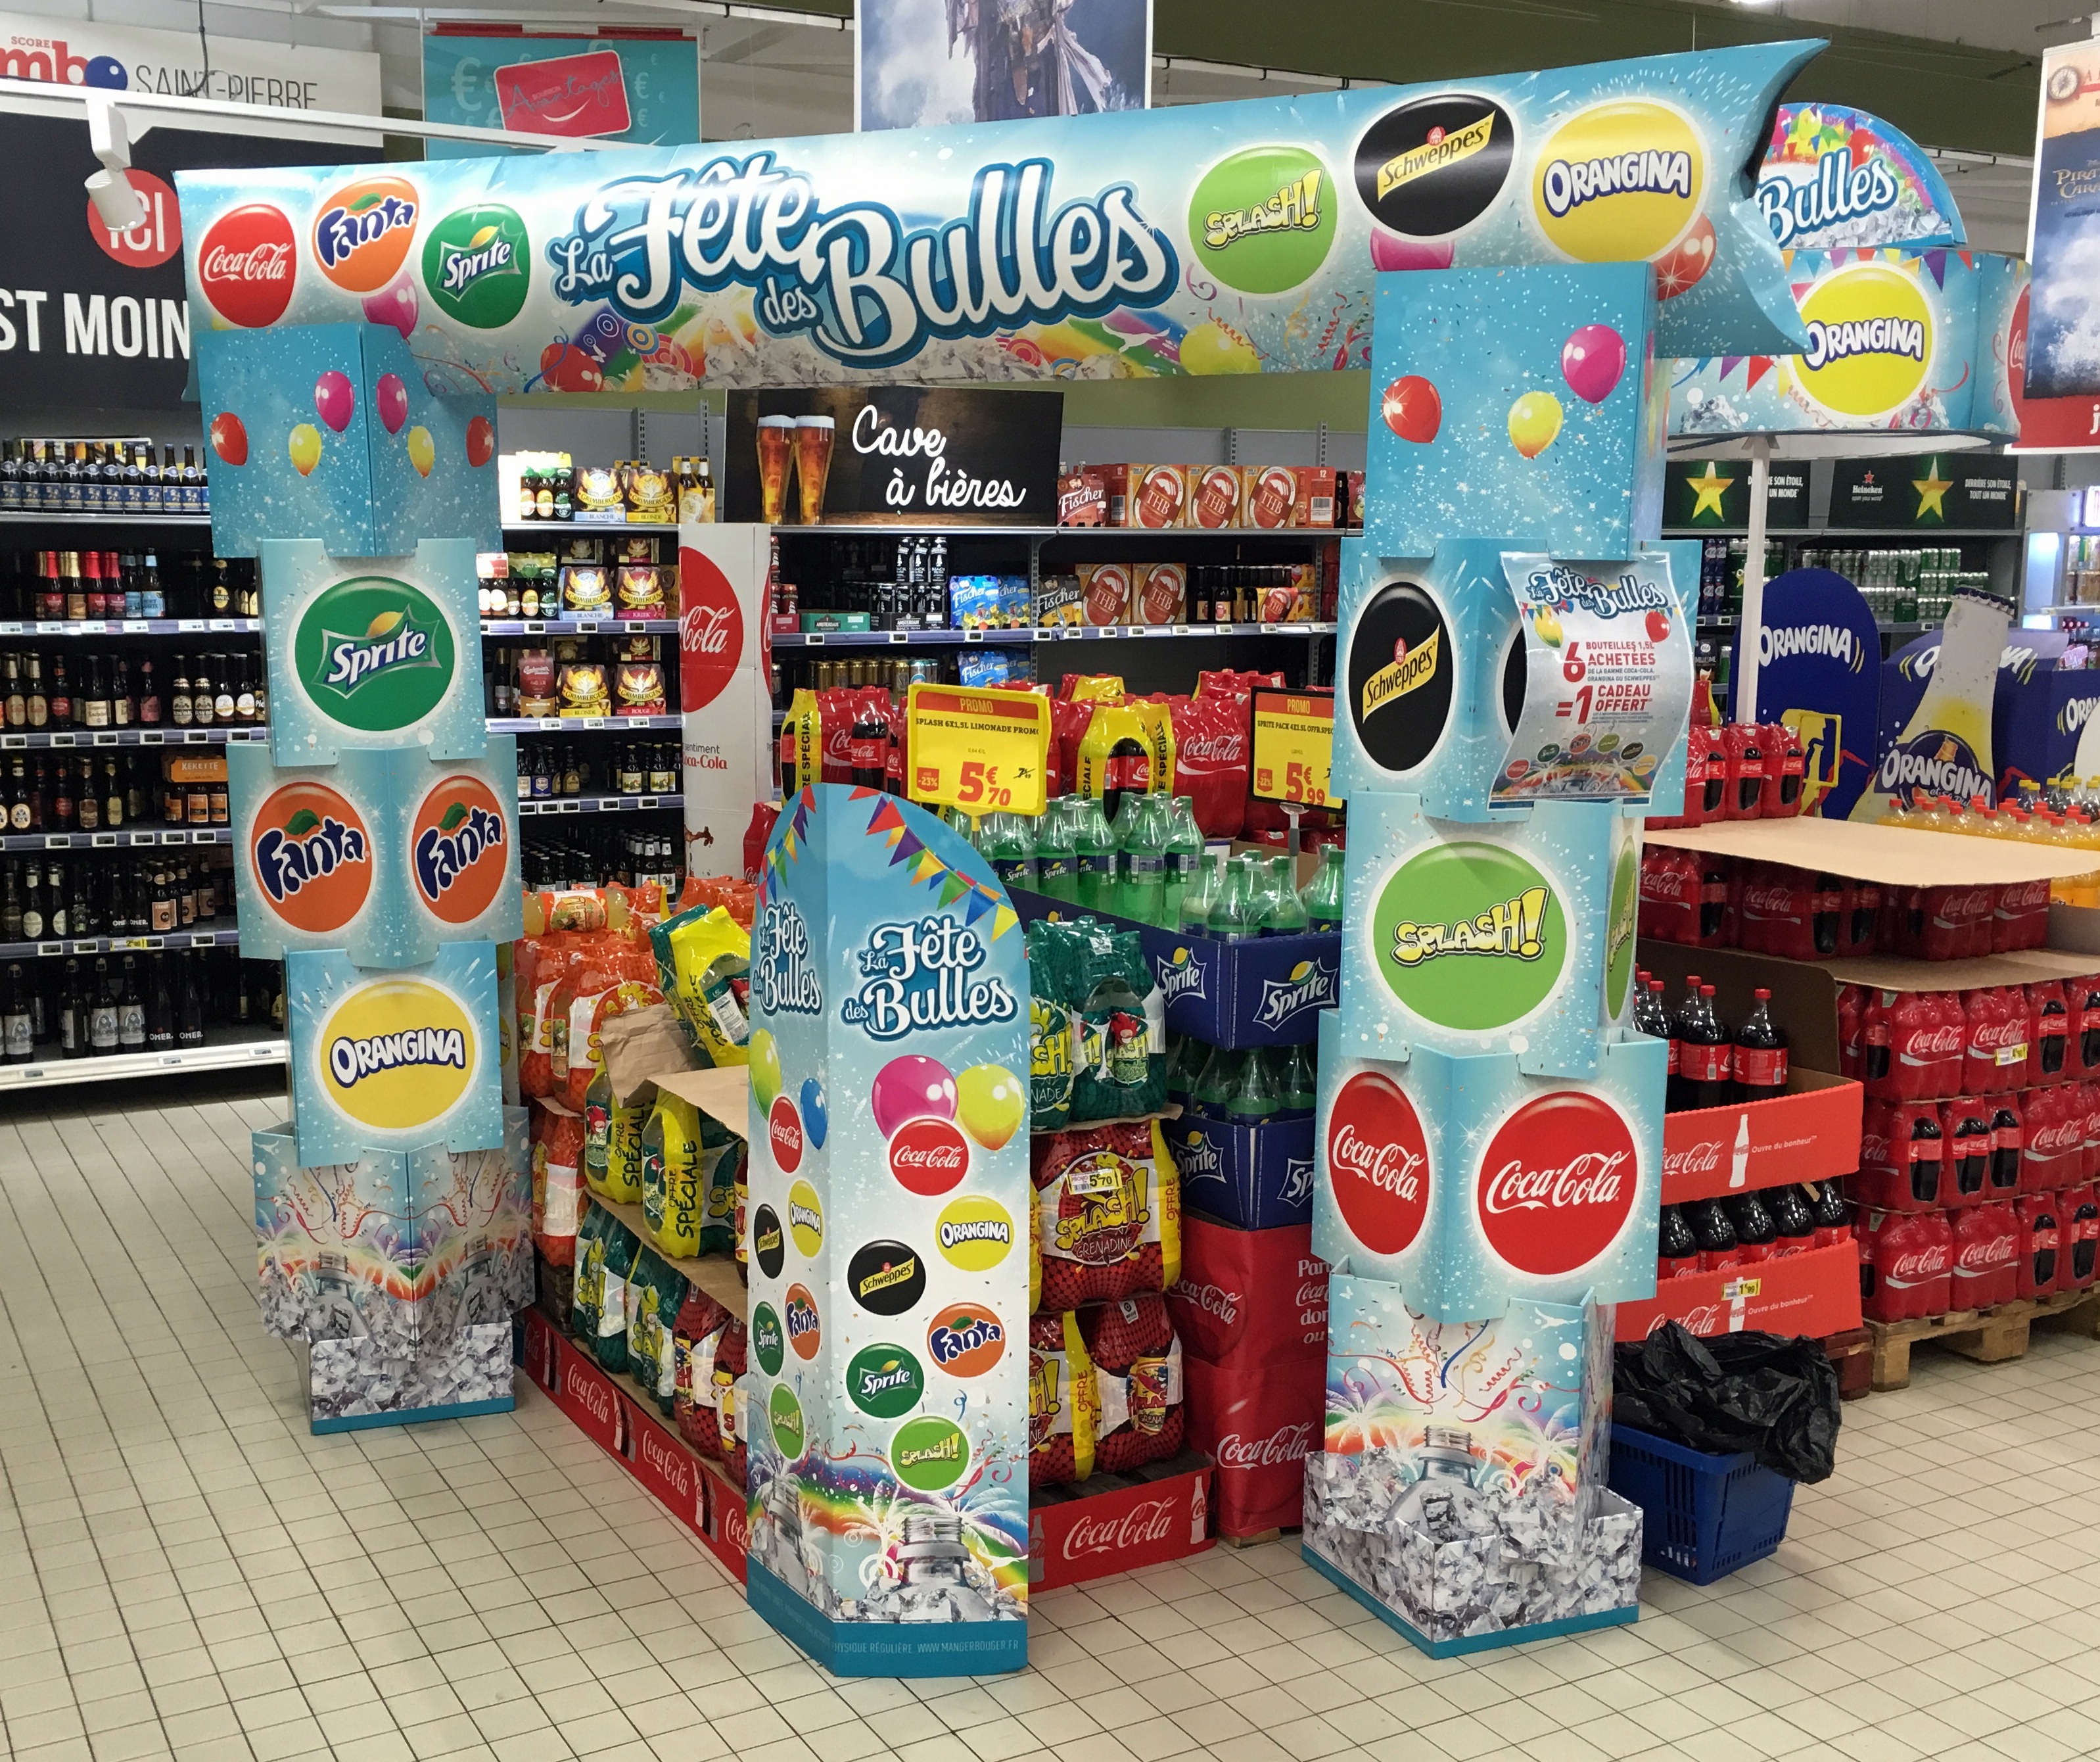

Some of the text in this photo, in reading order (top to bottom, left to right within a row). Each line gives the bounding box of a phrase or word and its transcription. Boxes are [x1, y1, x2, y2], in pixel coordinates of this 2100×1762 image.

[11, 36, 51, 48] SCORE
[1383, 125, 1485, 188] Schweppes
[1543, 150, 1692, 218] ORANGINA
[1760, 149, 1896, 243] Bulles
[1203, 168, 1322, 249] SPLASH!
[317, 196, 415, 267] Fanta
[553, 154, 815, 309] La Fête
[204, 242, 293, 283] Coca-Cola
[443, 238, 511, 291] Sprite
[762, 164, 1167, 356] des Bulles
[1805, 317, 1925, 370] ORANGINA
[852, 405, 946, 458] Cave
[885, 456, 1027, 507] à bières
[1769, 488, 1798, 498] UN MONDE
[1774, 476, 1785, 486] SON
[1852, 485, 1883, 494] Heineken
[581, 493, 623, 505] GRIMBERGEN
[632, 494, 673, 506] GRIMBERGEN
[1058, 486, 1104, 516] Fischer
[1148, 489, 1170, 515] THB
[1205, 489, 1226, 514] THB
[1261, 489, 1284, 514] THB
[568, 591, 609, 604] GRIMBERGEN
[621, 592, 662, 604] GRIMBERGEN
[952, 584, 986, 605] Fischer
[1038, 587, 1080, 616] Fischer
[1094, 588, 1117, 612] THB
[1149, 588, 1173, 612] THB
[1531, 568, 1587, 603] Fête
[1588, 576, 1667, 616] Bulles
[327, 621, 427, 687] Sprite
[1563, 642, 1586, 682] 6
[1586, 641, 1655, 650] BOUTEILLES 1,5L
[1758, 624, 1852, 667] ORANGINA
[962, 661, 994, 679] Fischer
[1366, 646, 1433, 709] Schweppes
[565, 688, 607, 701] GRIMBERGEN
[619, 688, 662, 701] GRIMBERGEN
[960, 698, 994, 714] PROMO
[1286, 698, 1311, 714] PROMO
[1595, 698, 1648, 711] OFFERT
[1598, 684, 1651, 697] CADEAU
[916, 717, 944, 727] SPLASH
[970, 723, 1012, 733] LIMONADE
[1257, 720, 1274, 728] SPRITE
[1183, 735, 1242, 763] Coca-Cola
[181, 761, 218, 771] KEKETTE
[918, 776, 938, 787] -23%
[1882, 748, 1994, 809] ORANGINA
[257, 817, 364, 902] Fanta
[415, 807, 502, 901] Fanta
[1006, 866, 1030, 882] Sprite
[1044, 865, 1067, 880] Sprite
[766, 905, 806, 958] Fête
[1391, 886, 1549, 965] SPLASH!
[862, 917, 982, 980] La Fête
[760, 953, 821, 1011] Bulles
[1160, 964, 1200, 998] Sprite
[1267, 972, 1328, 1018] Sprite
[845, 966, 1014, 1036] des Bulles
[1907, 1025, 1963, 1053] Coca-Cola
[1972, 1018, 2028, 1047] Coca-Cola
[331, 1028, 463, 1085] ORANGINA
[615, 1121, 625, 1159] OFFRE
[771, 1118, 800, 1151] Coca-Cola
[1752, 1144, 1771, 1154] Ouvre
[1774, 1141, 1783, 1151] du
[2032, 1120, 2083, 1149] Coca-Cola
[893, 1144, 965, 1169] Coca-Cola
[1177, 1145, 1218, 1178] Sprite
[1333, 1124, 1426, 1201] Coca-Cola
[668, 1167, 678, 1208] OFFRE
[676, 1139, 697, 1239] SPÉCIALE
[1485, 1149, 1633, 1215] Coca-Cola
[1056, 1167, 1151, 1249] SPLASH!
[1166, 1176, 1176, 1222] OFFRE
[790, 1202, 822, 1237] ORANGINA
[941, 1222, 1010, 1249] ORANGINA
[758, 1231, 780, 1249] Schweppes
[1076, 1234, 1134, 1256] GRENADINE
[1959, 1234, 2015, 1264] Coca-Cola
[862, 1262, 912, 1292] Schweppes
[1893, 1245, 1949, 1278] Coca-Cola
[787, 1303, 818, 1337] Fanta
[1748, 1302, 1779, 1315] Ouvre du
[758, 1328, 778, 1348] Sprite
[930, 1320, 1002, 1364] Fanta
[567, 1362, 609, 1424] Coca-Cola
[860, 1367, 911, 1394] Sprite
[1078, 1369, 1088, 1413] OFFRE
[773, 1408, 799, 1435] SPLASH!
[898, 1431, 962, 1468] SPLASH!
[1218, 1421, 1315, 1469] Coca-Cola
[642, 1429, 689, 1498] Coca-Cola
[1063, 1496, 1178, 1560] Coca-Cola
[833, 1642, 868, 1654] HYSIQUE
[917, 1640, 1019, 1654] WWW.MANGERBOUGER.FR
